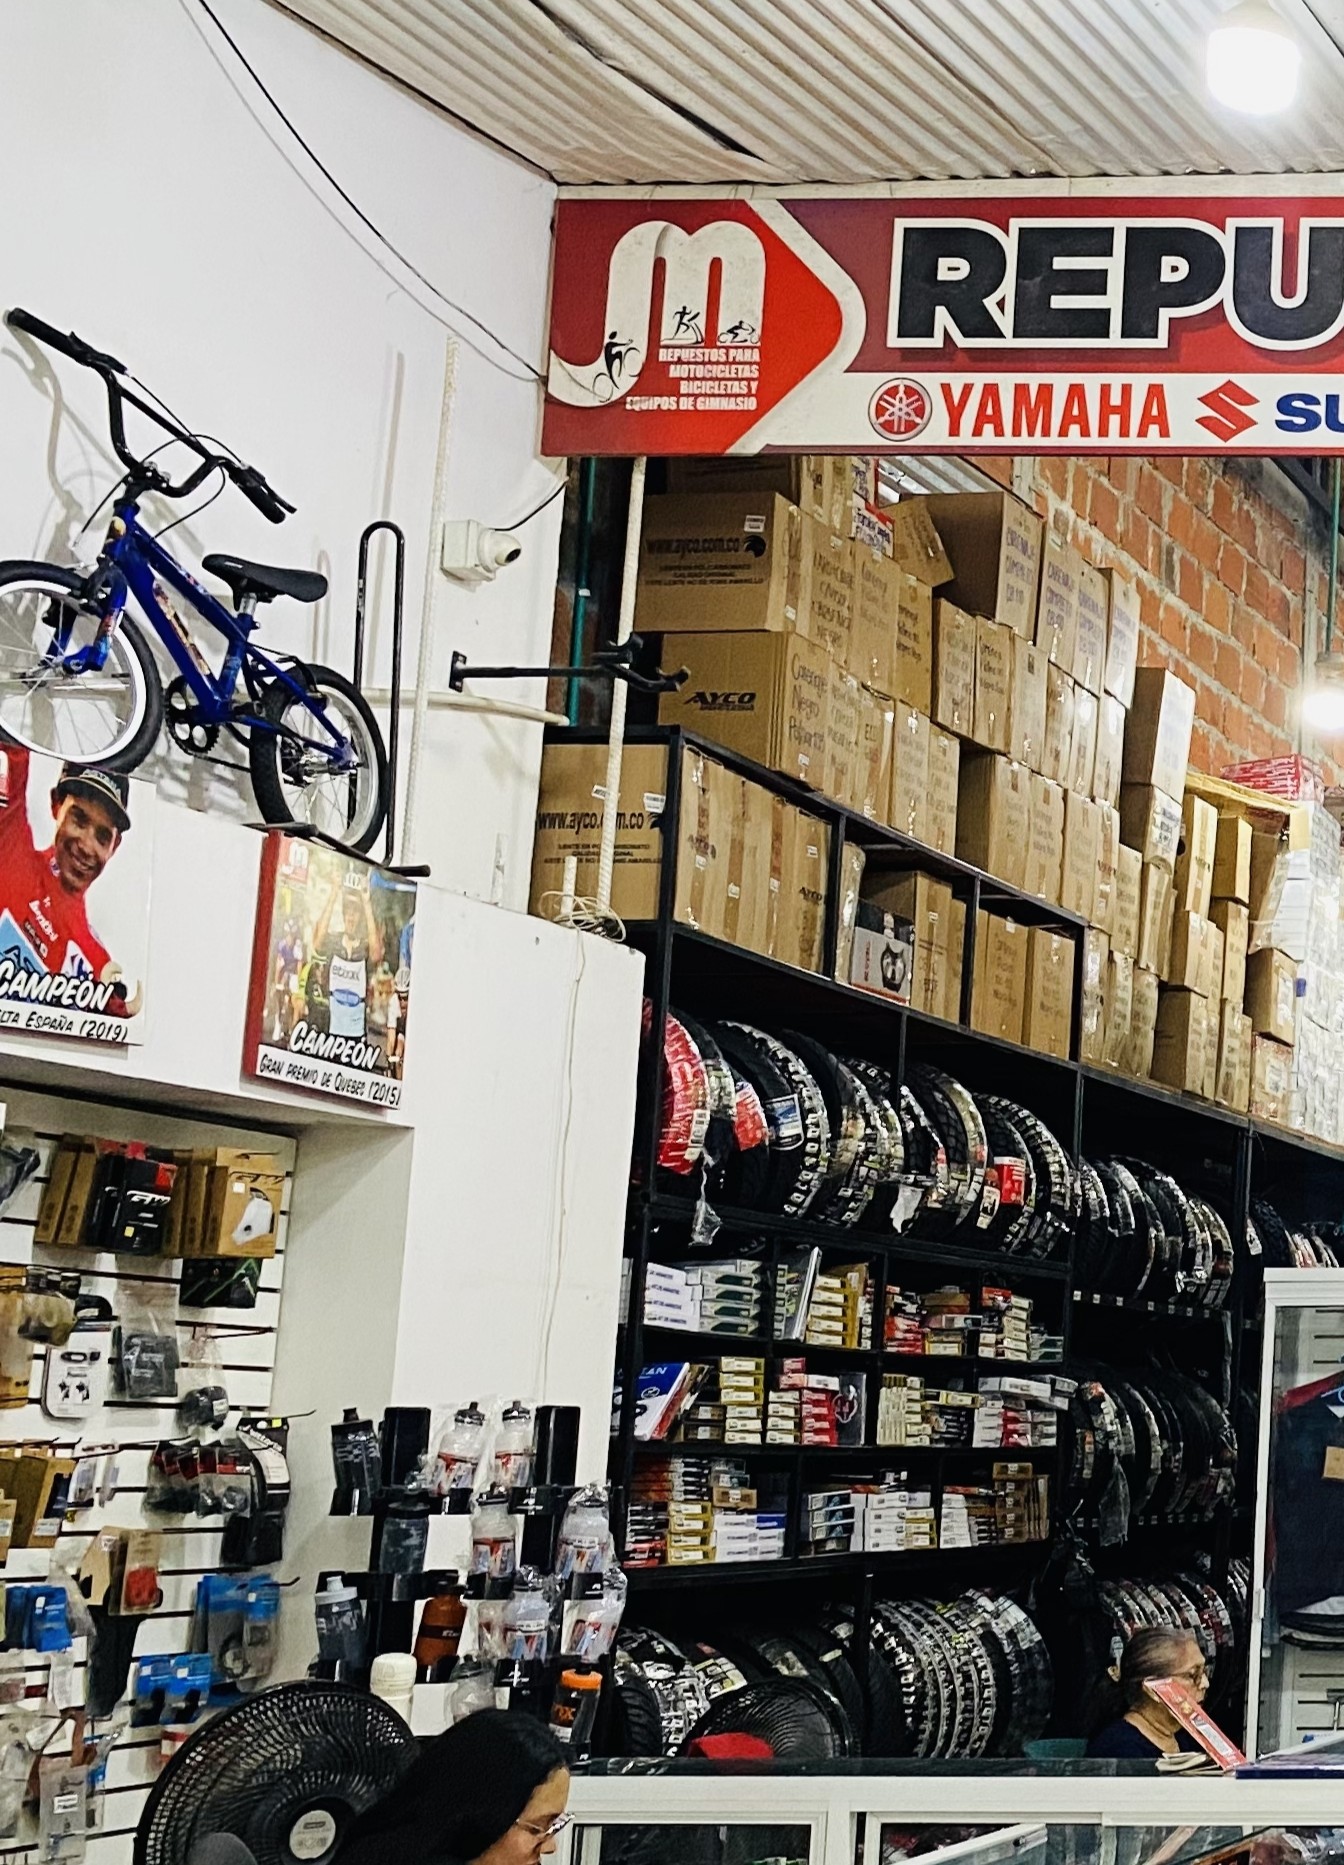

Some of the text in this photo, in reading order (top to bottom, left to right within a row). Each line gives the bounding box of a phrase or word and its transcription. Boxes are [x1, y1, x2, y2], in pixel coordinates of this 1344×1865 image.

[659, 349, 760, 362] REPUESTOS PARA
[669, 365, 760, 378] MOTOCICLETAS
[680, 381, 758, 394] BICICLETAS Y
[625, 396, 757, 411] EQUIPOS DE GIMNASIO
[939, 382, 1171, 440] YAMAHA
[684, 691, 757, 705] AYCO
[537, 812, 645, 835] www.ayco.m.co
[0, 960, 115, 1012] CAMPEÓN
[25, 1010, 74, 1033] ESPAÑA
[80, 1018, 129, 1043] (2019)
[290, 1020, 382, 1071] CAMPEÓN
[259, 1054, 283, 1079] GRAN
[286, 1062, 318, 1085] PREMIO
[321, 1069, 332, 1089] DE
[369, 1080, 401, 1106] (2015)
